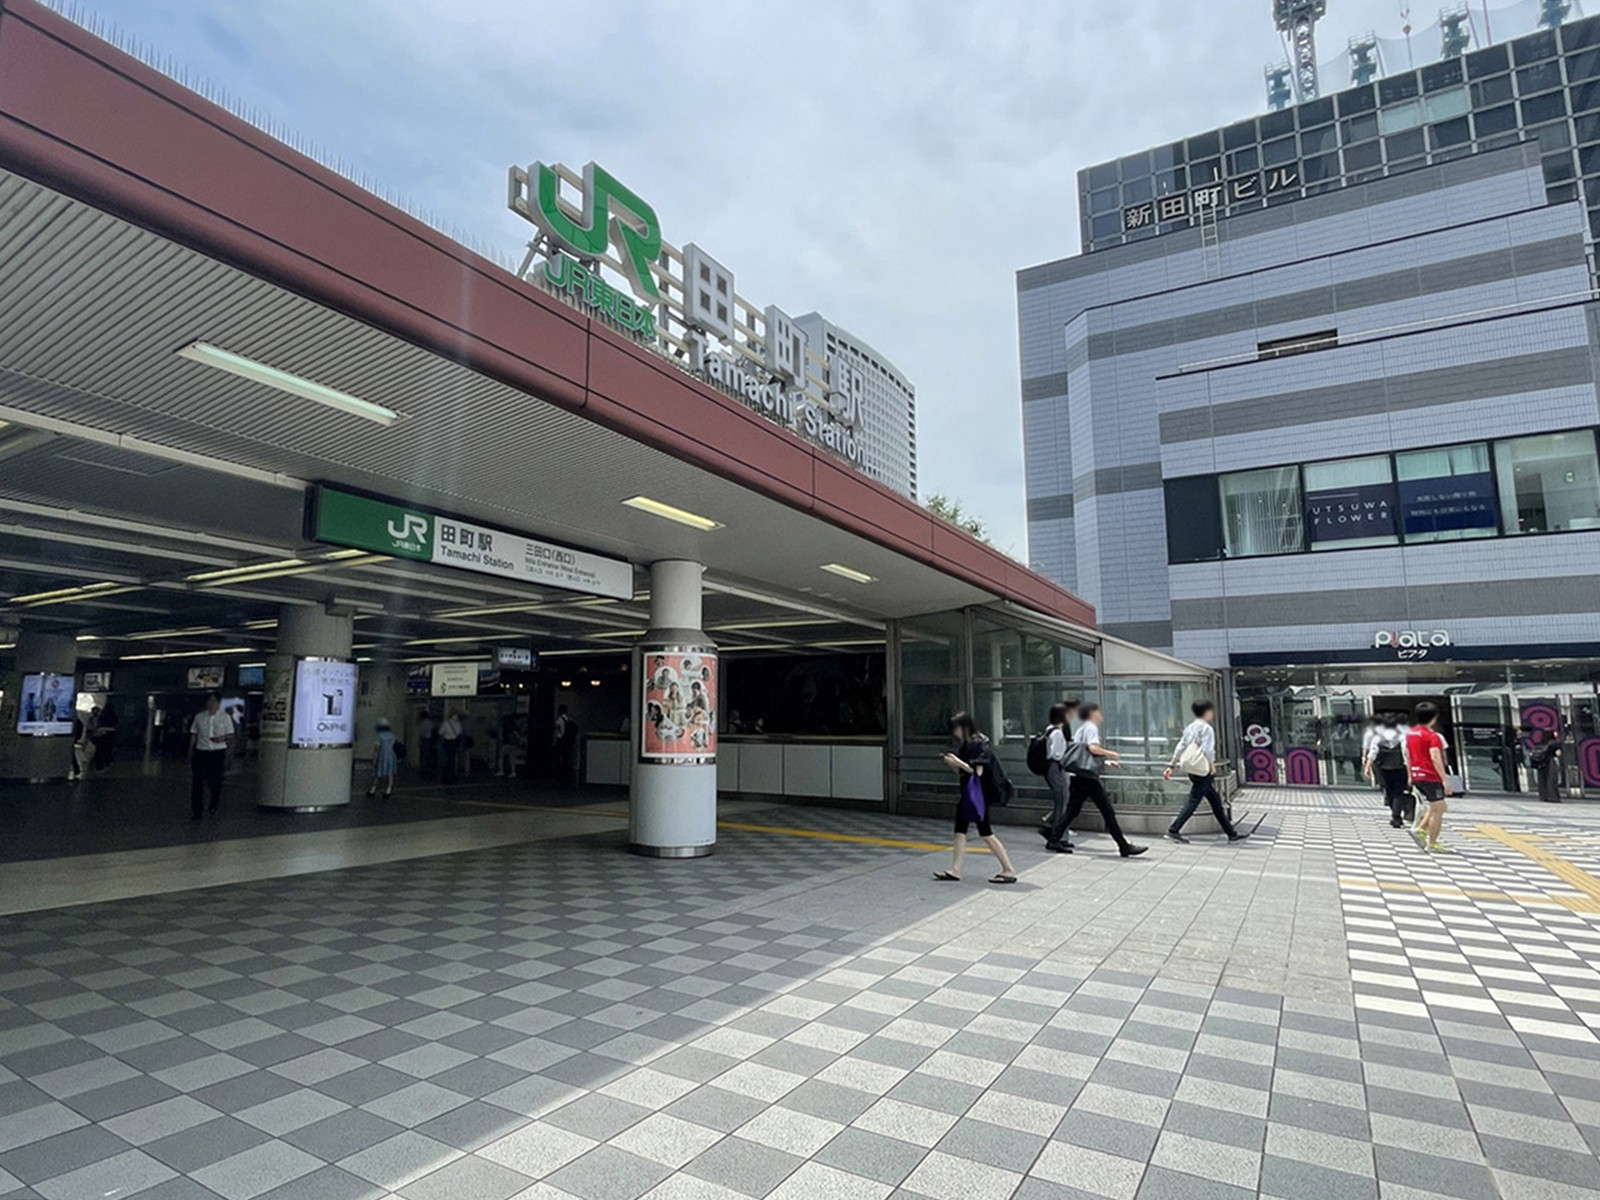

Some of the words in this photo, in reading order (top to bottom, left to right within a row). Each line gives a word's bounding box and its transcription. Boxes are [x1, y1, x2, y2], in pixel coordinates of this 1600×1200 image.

[1126, 168, 1298, 228] 新田町ビル
[528, 160, 662, 301] JR
[542, 254, 657, 338] JR東日本
[683, 242, 866, 428] 田町駅
[685, 331, 798, 425] Tamachi
[802, 403, 867, 467] Station
[387, 513, 429, 545] JR
[1312, 500, 1388, 515] UTSUWA
[1313, 511, 1389, 526] FLOWER
[440, 524, 493, 553] 田町駅
[440, 545, 482, 563] Tamachi
[482, 554, 515, 571] Station
